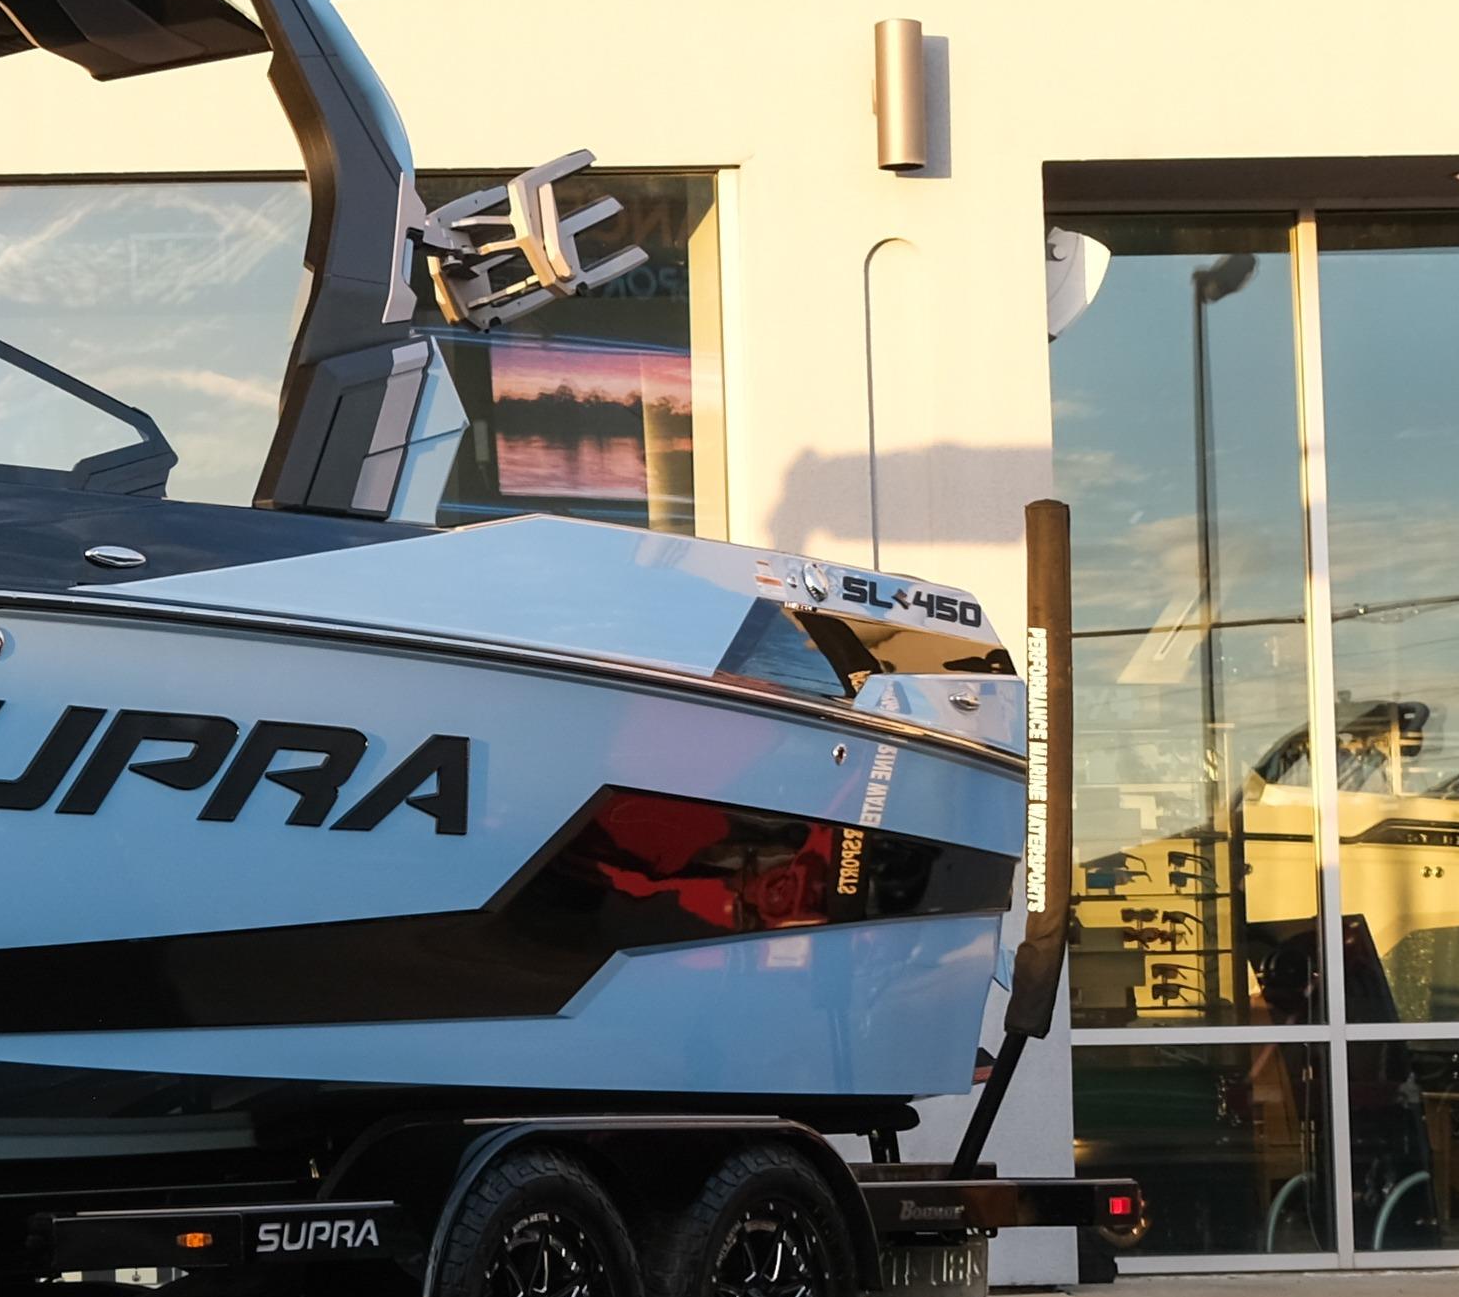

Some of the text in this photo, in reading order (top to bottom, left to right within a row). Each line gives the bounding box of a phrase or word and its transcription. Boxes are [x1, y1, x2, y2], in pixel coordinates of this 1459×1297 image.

[842, 575, 982, 628] SL 450
[1027, 627, 1048, 913] PERFORMANCE MARINE WATERSPORTS
[255, 1219, 380, 1253] SUPRA
